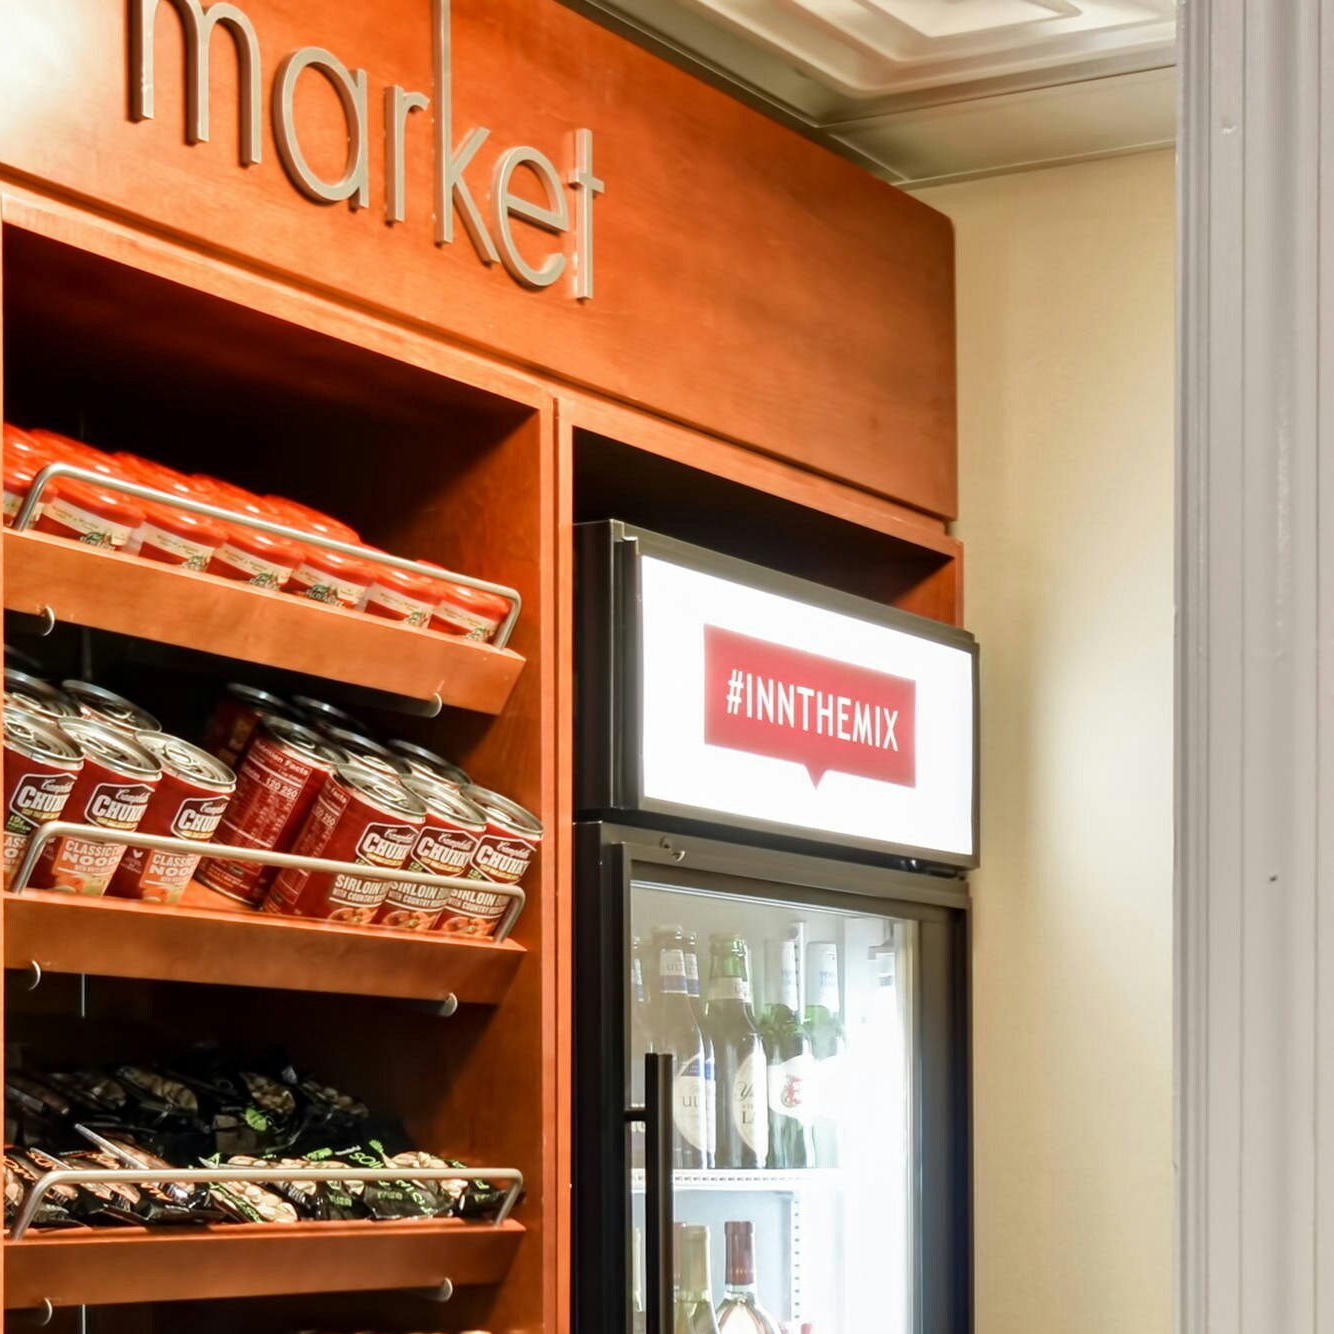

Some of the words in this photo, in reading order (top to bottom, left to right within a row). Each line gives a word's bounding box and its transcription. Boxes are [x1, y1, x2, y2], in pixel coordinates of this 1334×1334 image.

[129, 0, 605, 301] market
[725, 668, 900, 752] #INNTHEMIX
[334, 874, 383, 896] SIRLOIN
[390, 880, 439, 900] SIRLOIN
